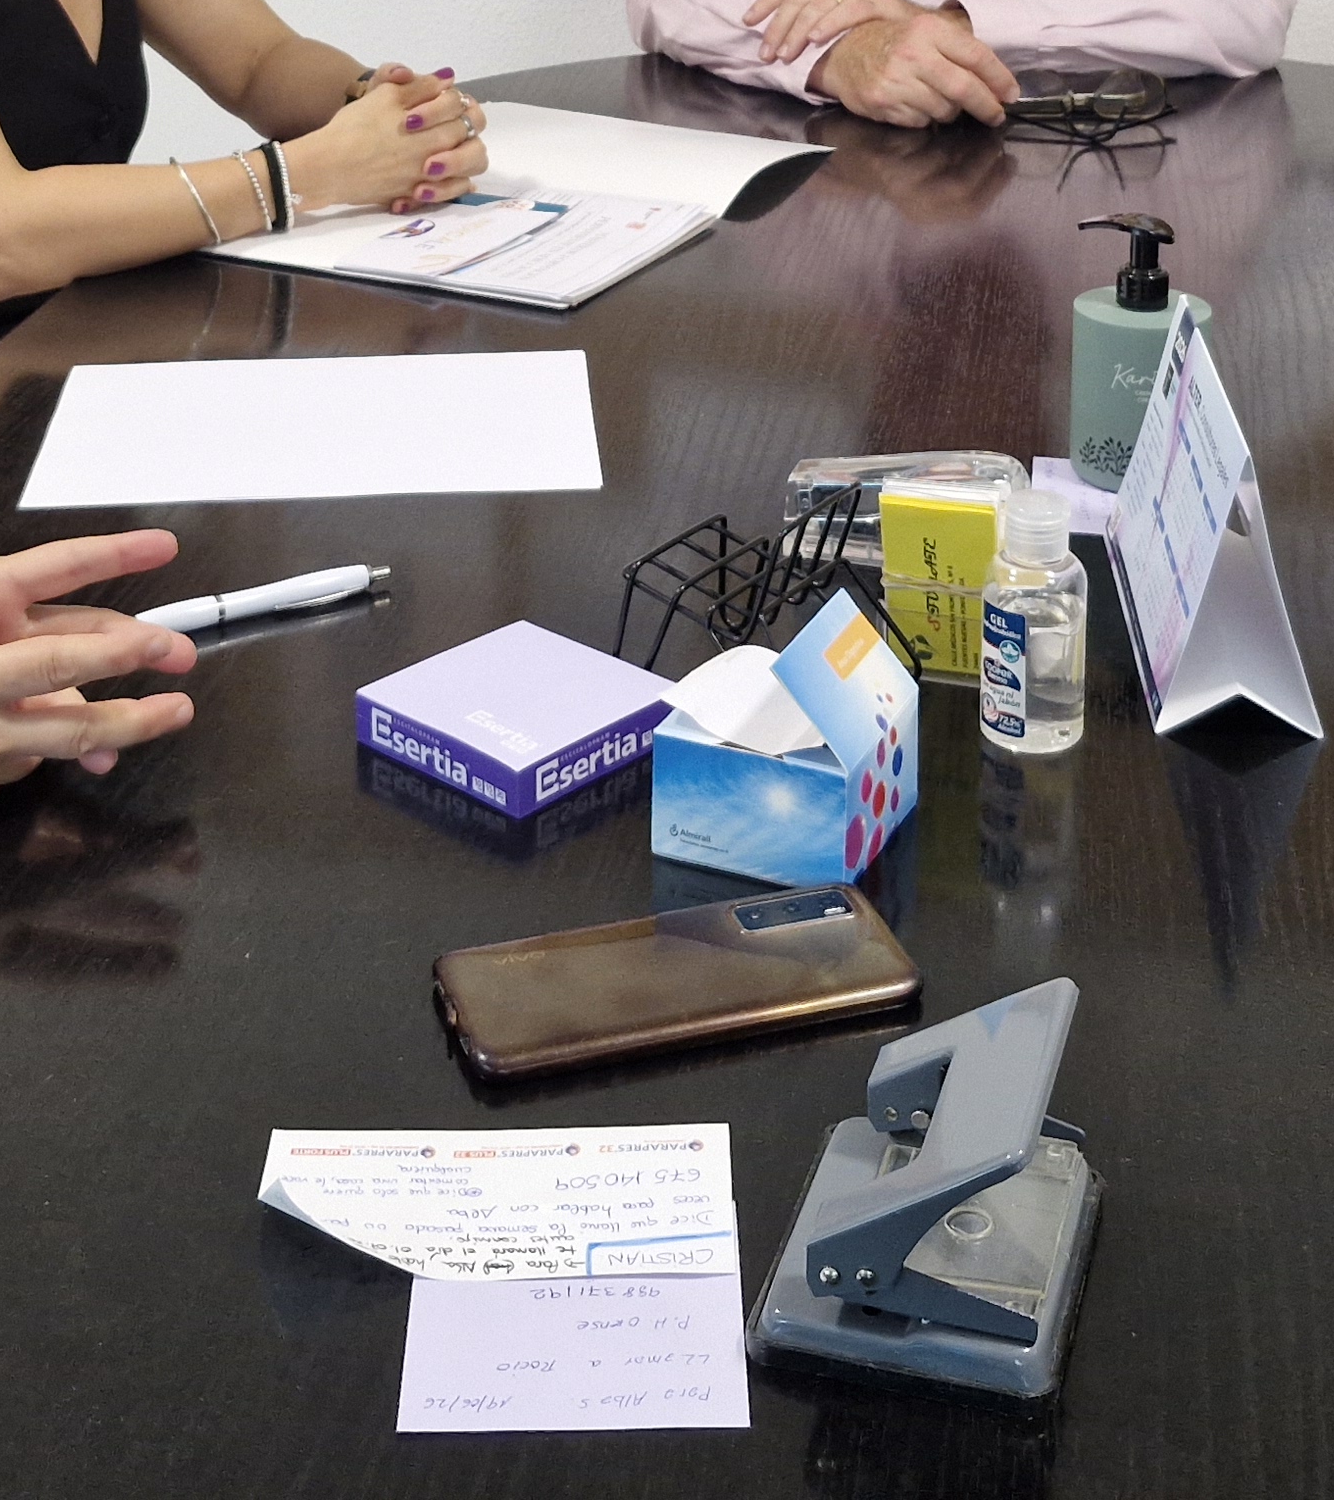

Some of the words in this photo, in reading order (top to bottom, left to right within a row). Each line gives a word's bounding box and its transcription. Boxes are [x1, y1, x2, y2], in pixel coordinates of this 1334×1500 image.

[989, 613, 1009, 629] GEL
[467, 709, 541, 750] Esertia
[371, 706, 468, 787] Esertia
[536, 730, 637, 802] Esertia
[680, 828, 712, 842] Almirall
[358, 1149, 419, 1157] PARAPRES
[500, 1148, 564, 1157] PARAPRES
[618, 1143, 687, 1152] PARAPRES
[555, 1175, 600, 1190] 509
[604, 1170, 644, 1187] 140
[654, 1168, 701, 1184] 675
[622, 1197, 655, 1210] para
[673, 1195, 711, 1204] veces
[446, 1205, 498, 1219] Alba
[510, 1204, 540, 1213] con
[553, 1203, 613, 1219] hablar
[631, 1215, 659, 1230] que
[670, 1210, 715, 1226] Dice
[478, 1223, 538, 1234] semana
[463, 1247, 476, 1257] el
[555, 1246, 577, 1256] te
[608, 1248, 715, 1266] CRISTIAN
[527, 1258, 560, 1274] Para
